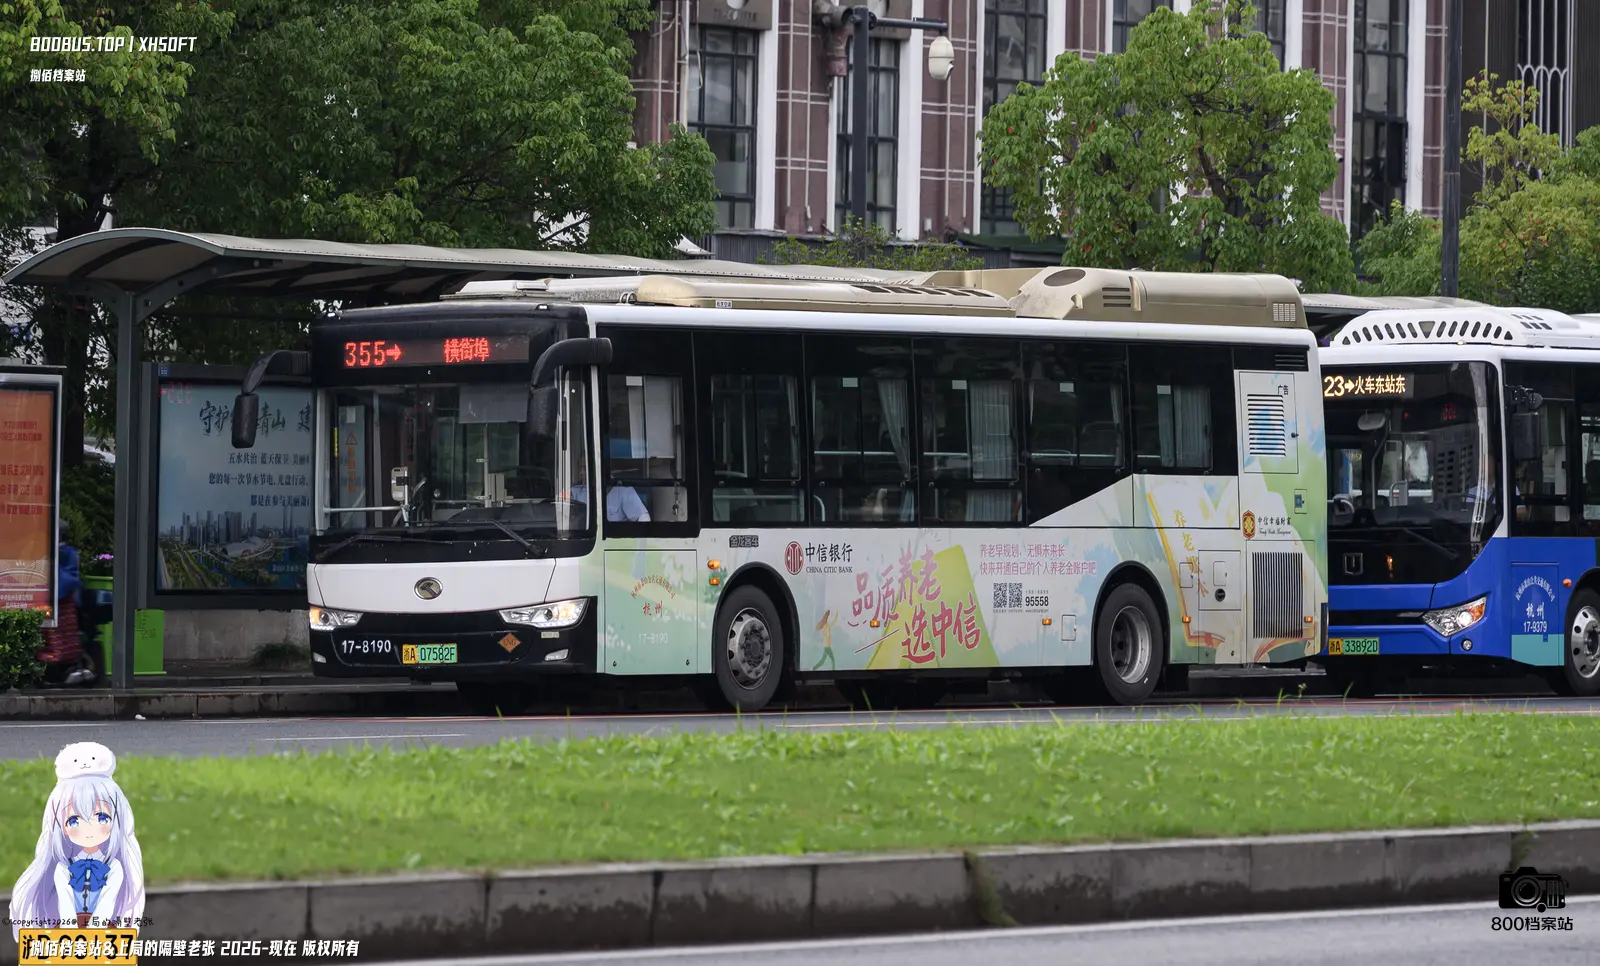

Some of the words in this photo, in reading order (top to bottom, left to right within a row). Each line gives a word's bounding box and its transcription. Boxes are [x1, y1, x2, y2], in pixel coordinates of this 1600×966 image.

[345, 341, 386, 367] 355
[1277, 384, 1289, 396] 广告
[1323, 375, 1345, 397] 23
[1354, 374, 1406, 395] 火车东站东
[200, 400, 286, 437] 守护青山
[228, 453, 258, 465] 五水共治
[730, 535, 759, 548] 金龙客车
[805, 542, 853, 563] 中信银行
[805, 566, 822, 574] CHINA
[823, 566, 837, 574] CITIC
[838, 566, 853, 574] BANK
[980, 561, 1098, 576] 快来开通自己的个人养老金账户吧
[851, 538, 942, 629] 品质养老
[1025, 596, 1049, 607] 95558
[642, 600, 663, 618] 杭州
[901, 592, 981, 664] 选中信
[1523, 621, 1548, 633] 17-9379
[638, 633, 668, 645] 17-8190
[341, 640, 392, 654] 17-8190
